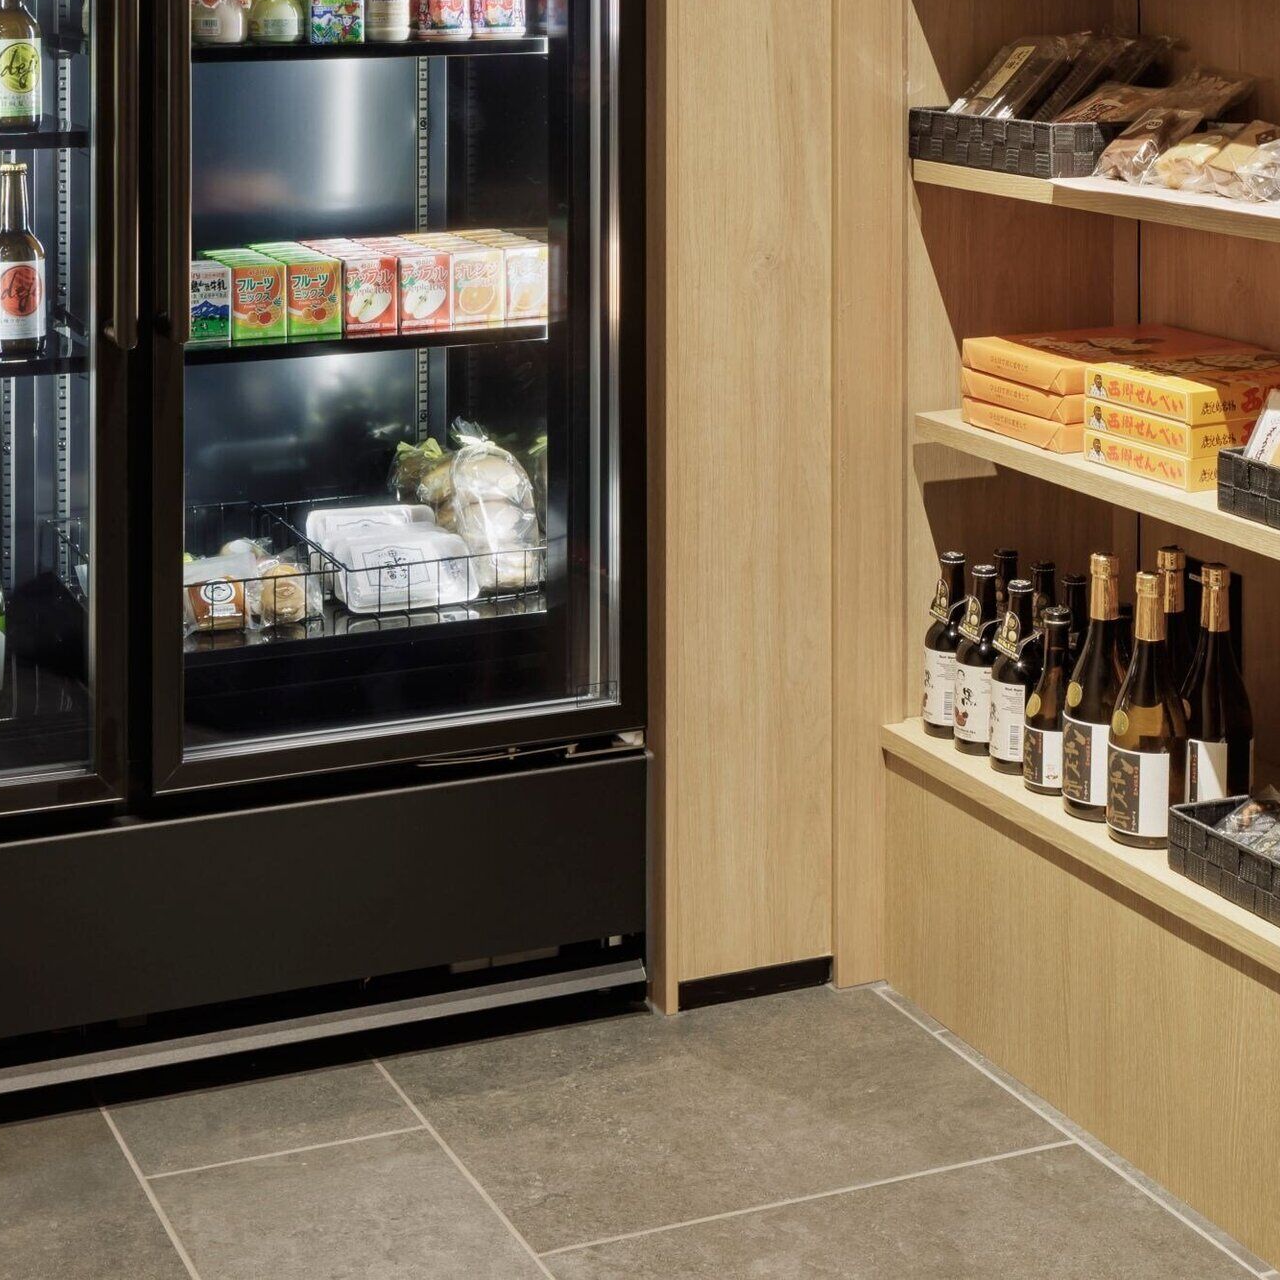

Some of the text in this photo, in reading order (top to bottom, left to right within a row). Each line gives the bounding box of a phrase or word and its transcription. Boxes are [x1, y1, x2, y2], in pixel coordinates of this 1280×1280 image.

[291, 273, 329, 291] フルーツ
[346, 269, 395, 287] アップル
[401, 266, 448, 284] アップル
[237, 276, 274, 293] フルーツ
[239, 292, 271, 304] ミックス
[293, 289, 326, 301] ミックス
[1108, 380, 1184, 412] 西郷せんべい
[1107, 412, 1184, 446] 西郷せんべい
[1106, 445, 1183, 480] 西郷せんべい
